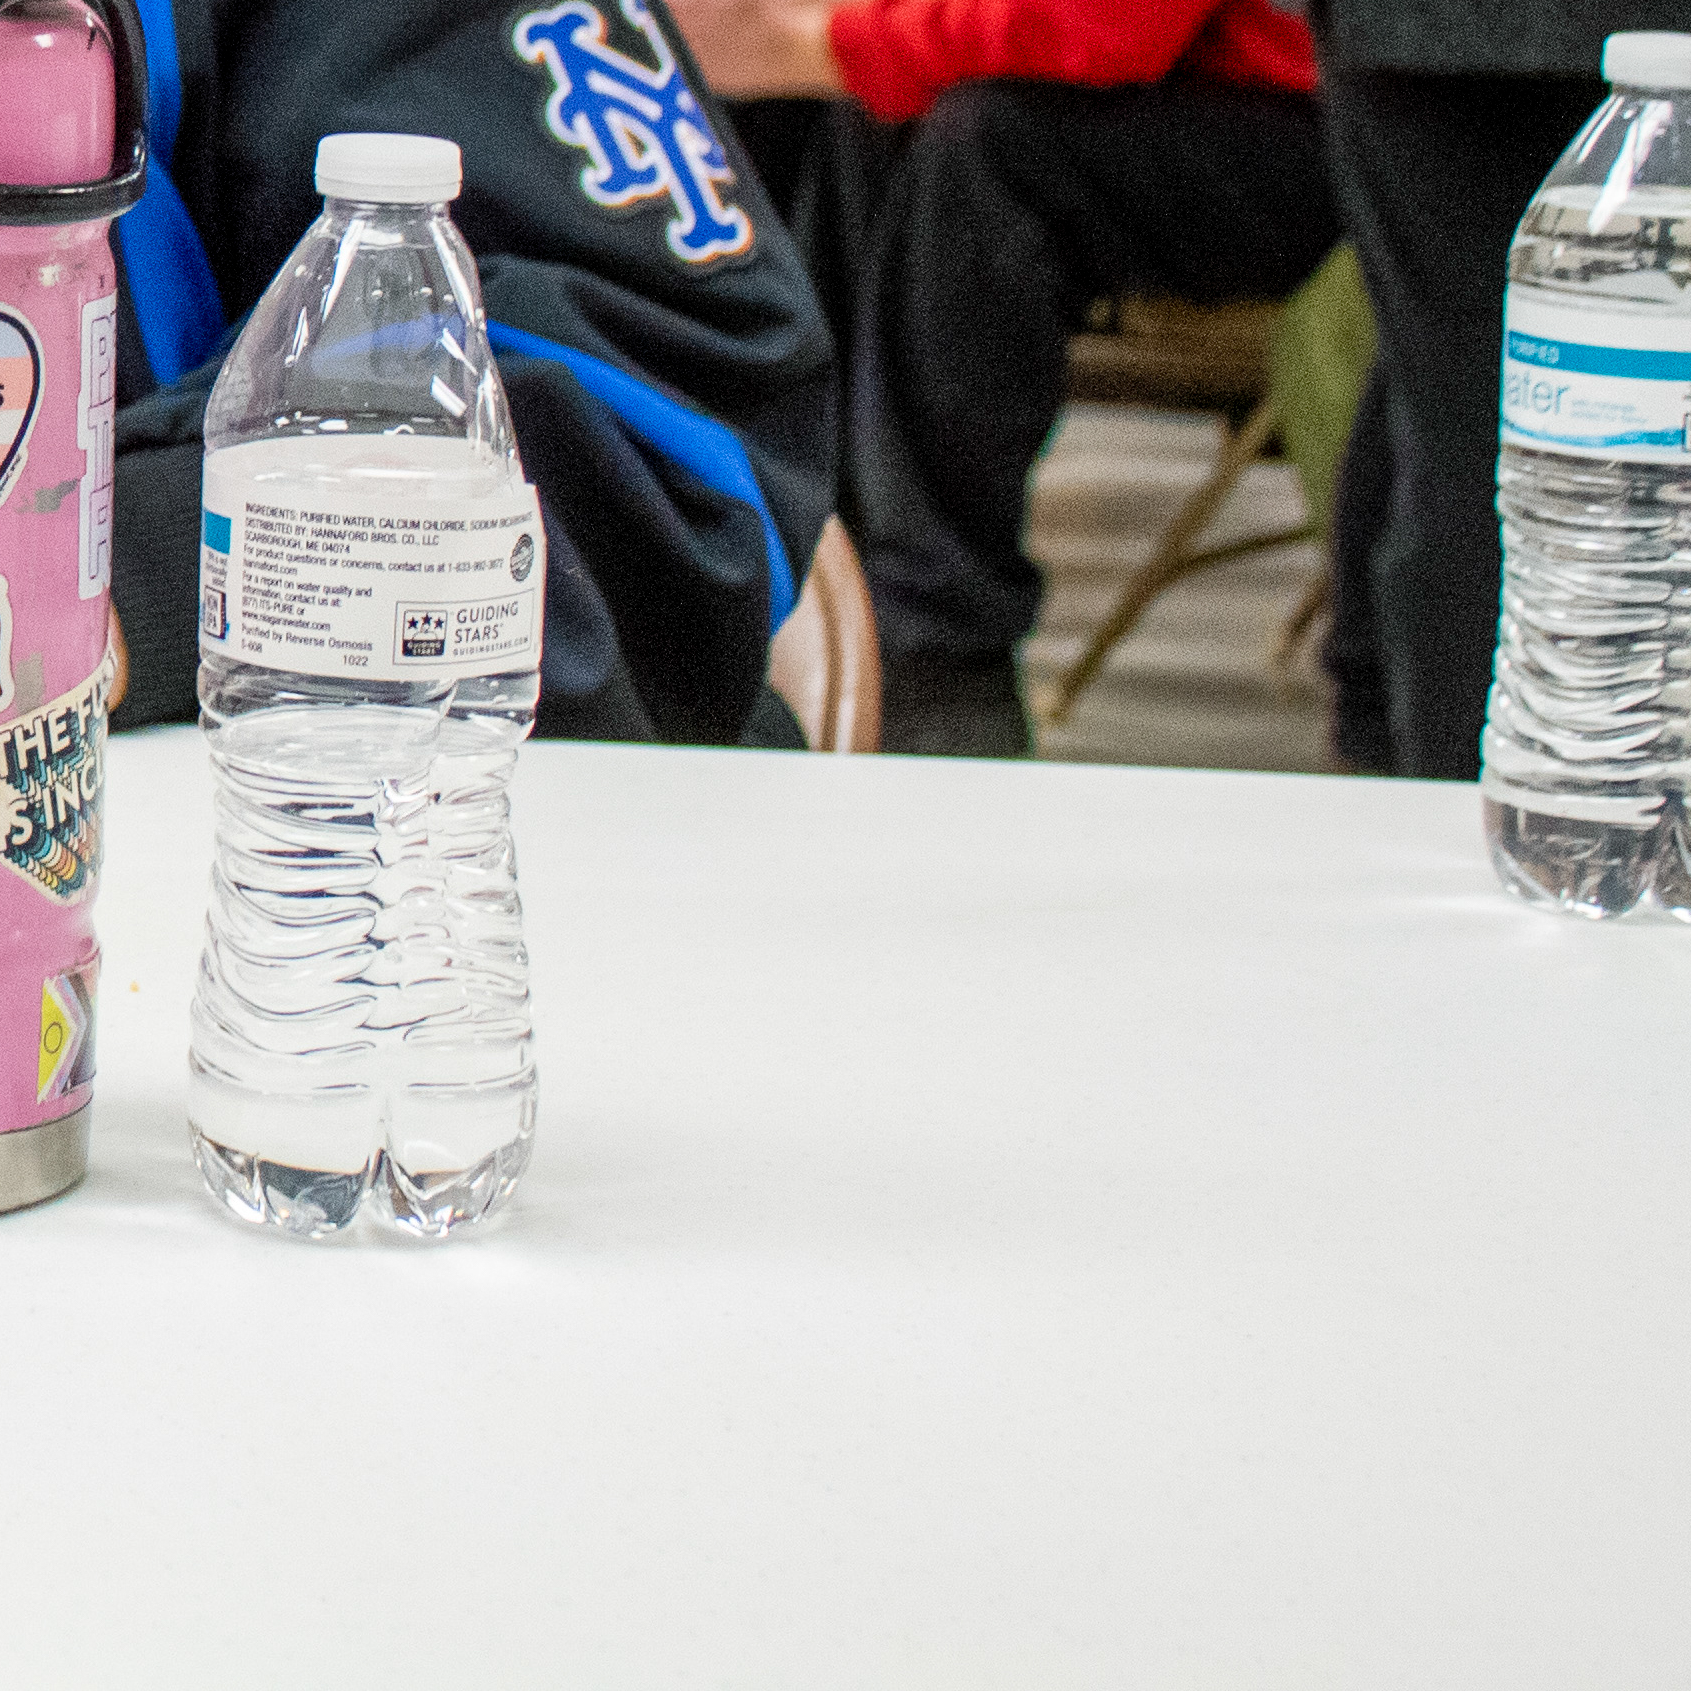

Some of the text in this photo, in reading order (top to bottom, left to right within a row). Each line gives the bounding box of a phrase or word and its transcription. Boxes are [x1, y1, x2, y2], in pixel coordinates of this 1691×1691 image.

[1506, 371, 1570, 414] ater
[300, 511, 340, 526] PURIFIED
[342, 515, 376, 529] WATER,
[379, 517, 420, 530] CALCIUM
[311, 527, 368, 542] HANNAFORD
[422, 534, 440, 545] LLC
[256, 548, 284, 561] product
[286, 553, 327, 566] questions
[388, 561, 421, 573] contact
[424, 563, 434, 573] us
[437, 562, 445, 573] at
[260, 576, 282, 588] report
[284, 580, 294, 589] on
[296, 582, 320, 592] water
[323, 585, 352, 597] quality
[355, 587, 372, 597] and
[284, 592, 316, 605] contact
[318, 596, 328, 606] us
[457, 601, 518, 624] GUIDING
[272, 630, 283, 644] by
[285, 631, 325, 647] Reverse
[328, 636, 373, 652] Osmosis
[454, 624, 499, 644] STARS
[343, 654, 369, 666] 1022
[42, 755, 105, 831] INCL
